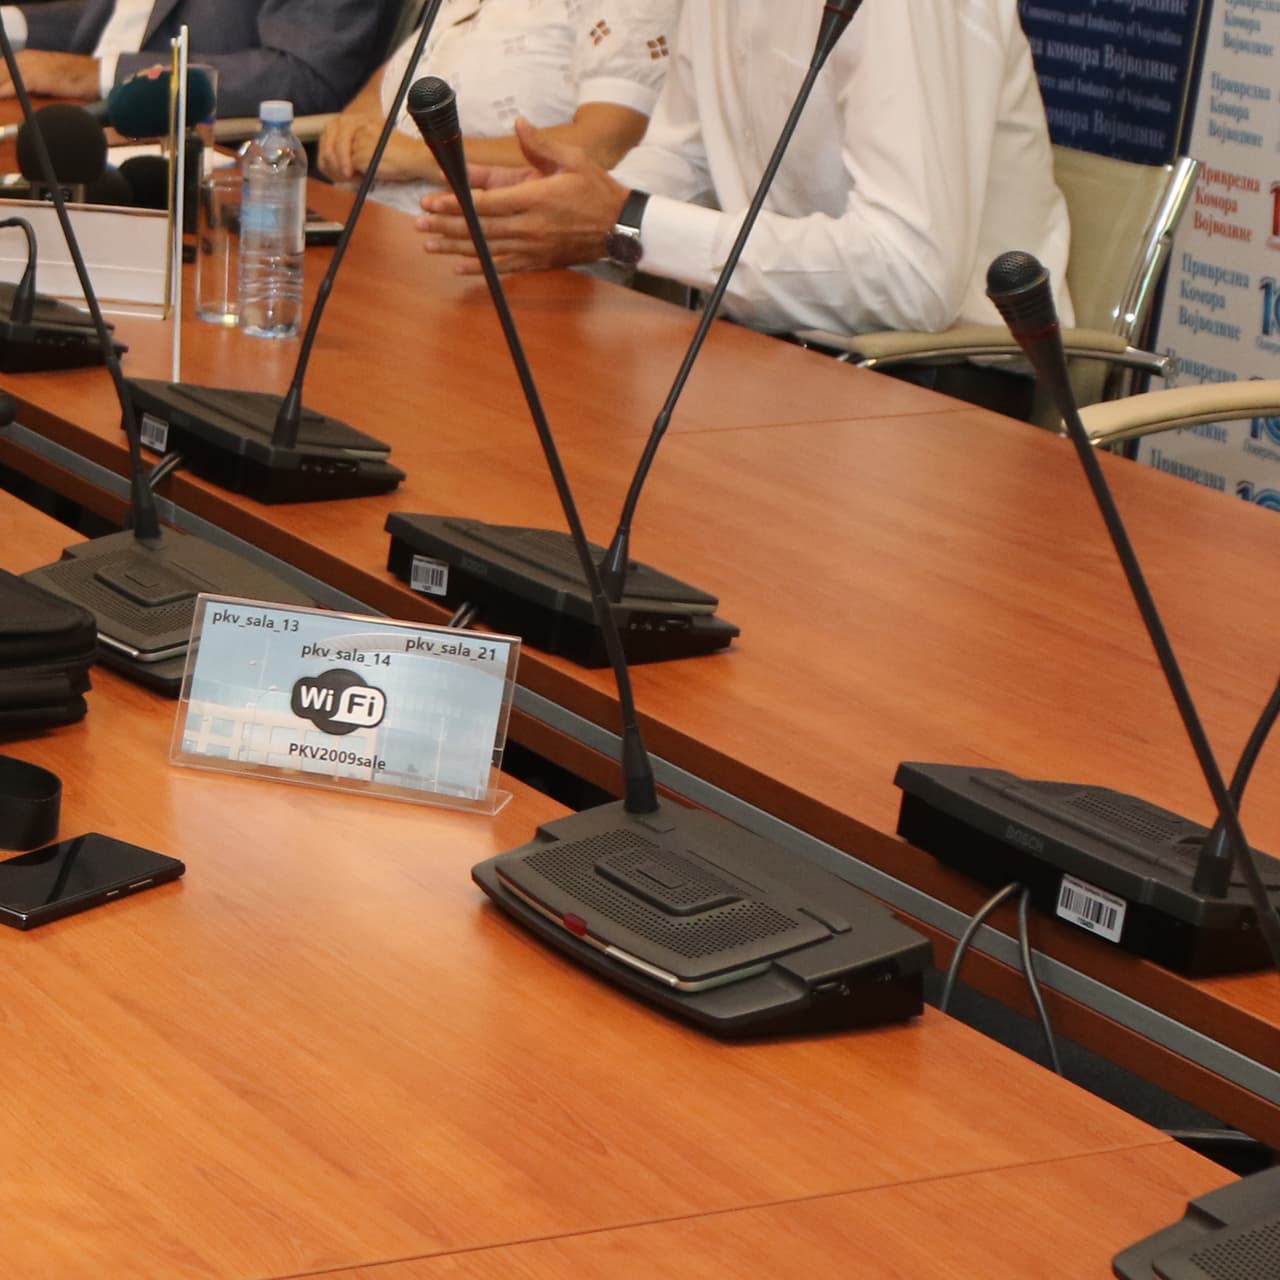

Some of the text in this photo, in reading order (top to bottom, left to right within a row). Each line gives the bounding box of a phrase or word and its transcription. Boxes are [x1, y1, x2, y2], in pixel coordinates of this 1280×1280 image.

[1195, 185, 1238, 216] Комора
[1193, 211, 1253, 242] Војводине
[212, 609, 300, 632] pkv_sala_13
[301, 642, 391, 667] pkv_sala_14
[405, 637, 496, 662] pkv_sala_21
[288, 743, 386, 771] PKV2009sale
